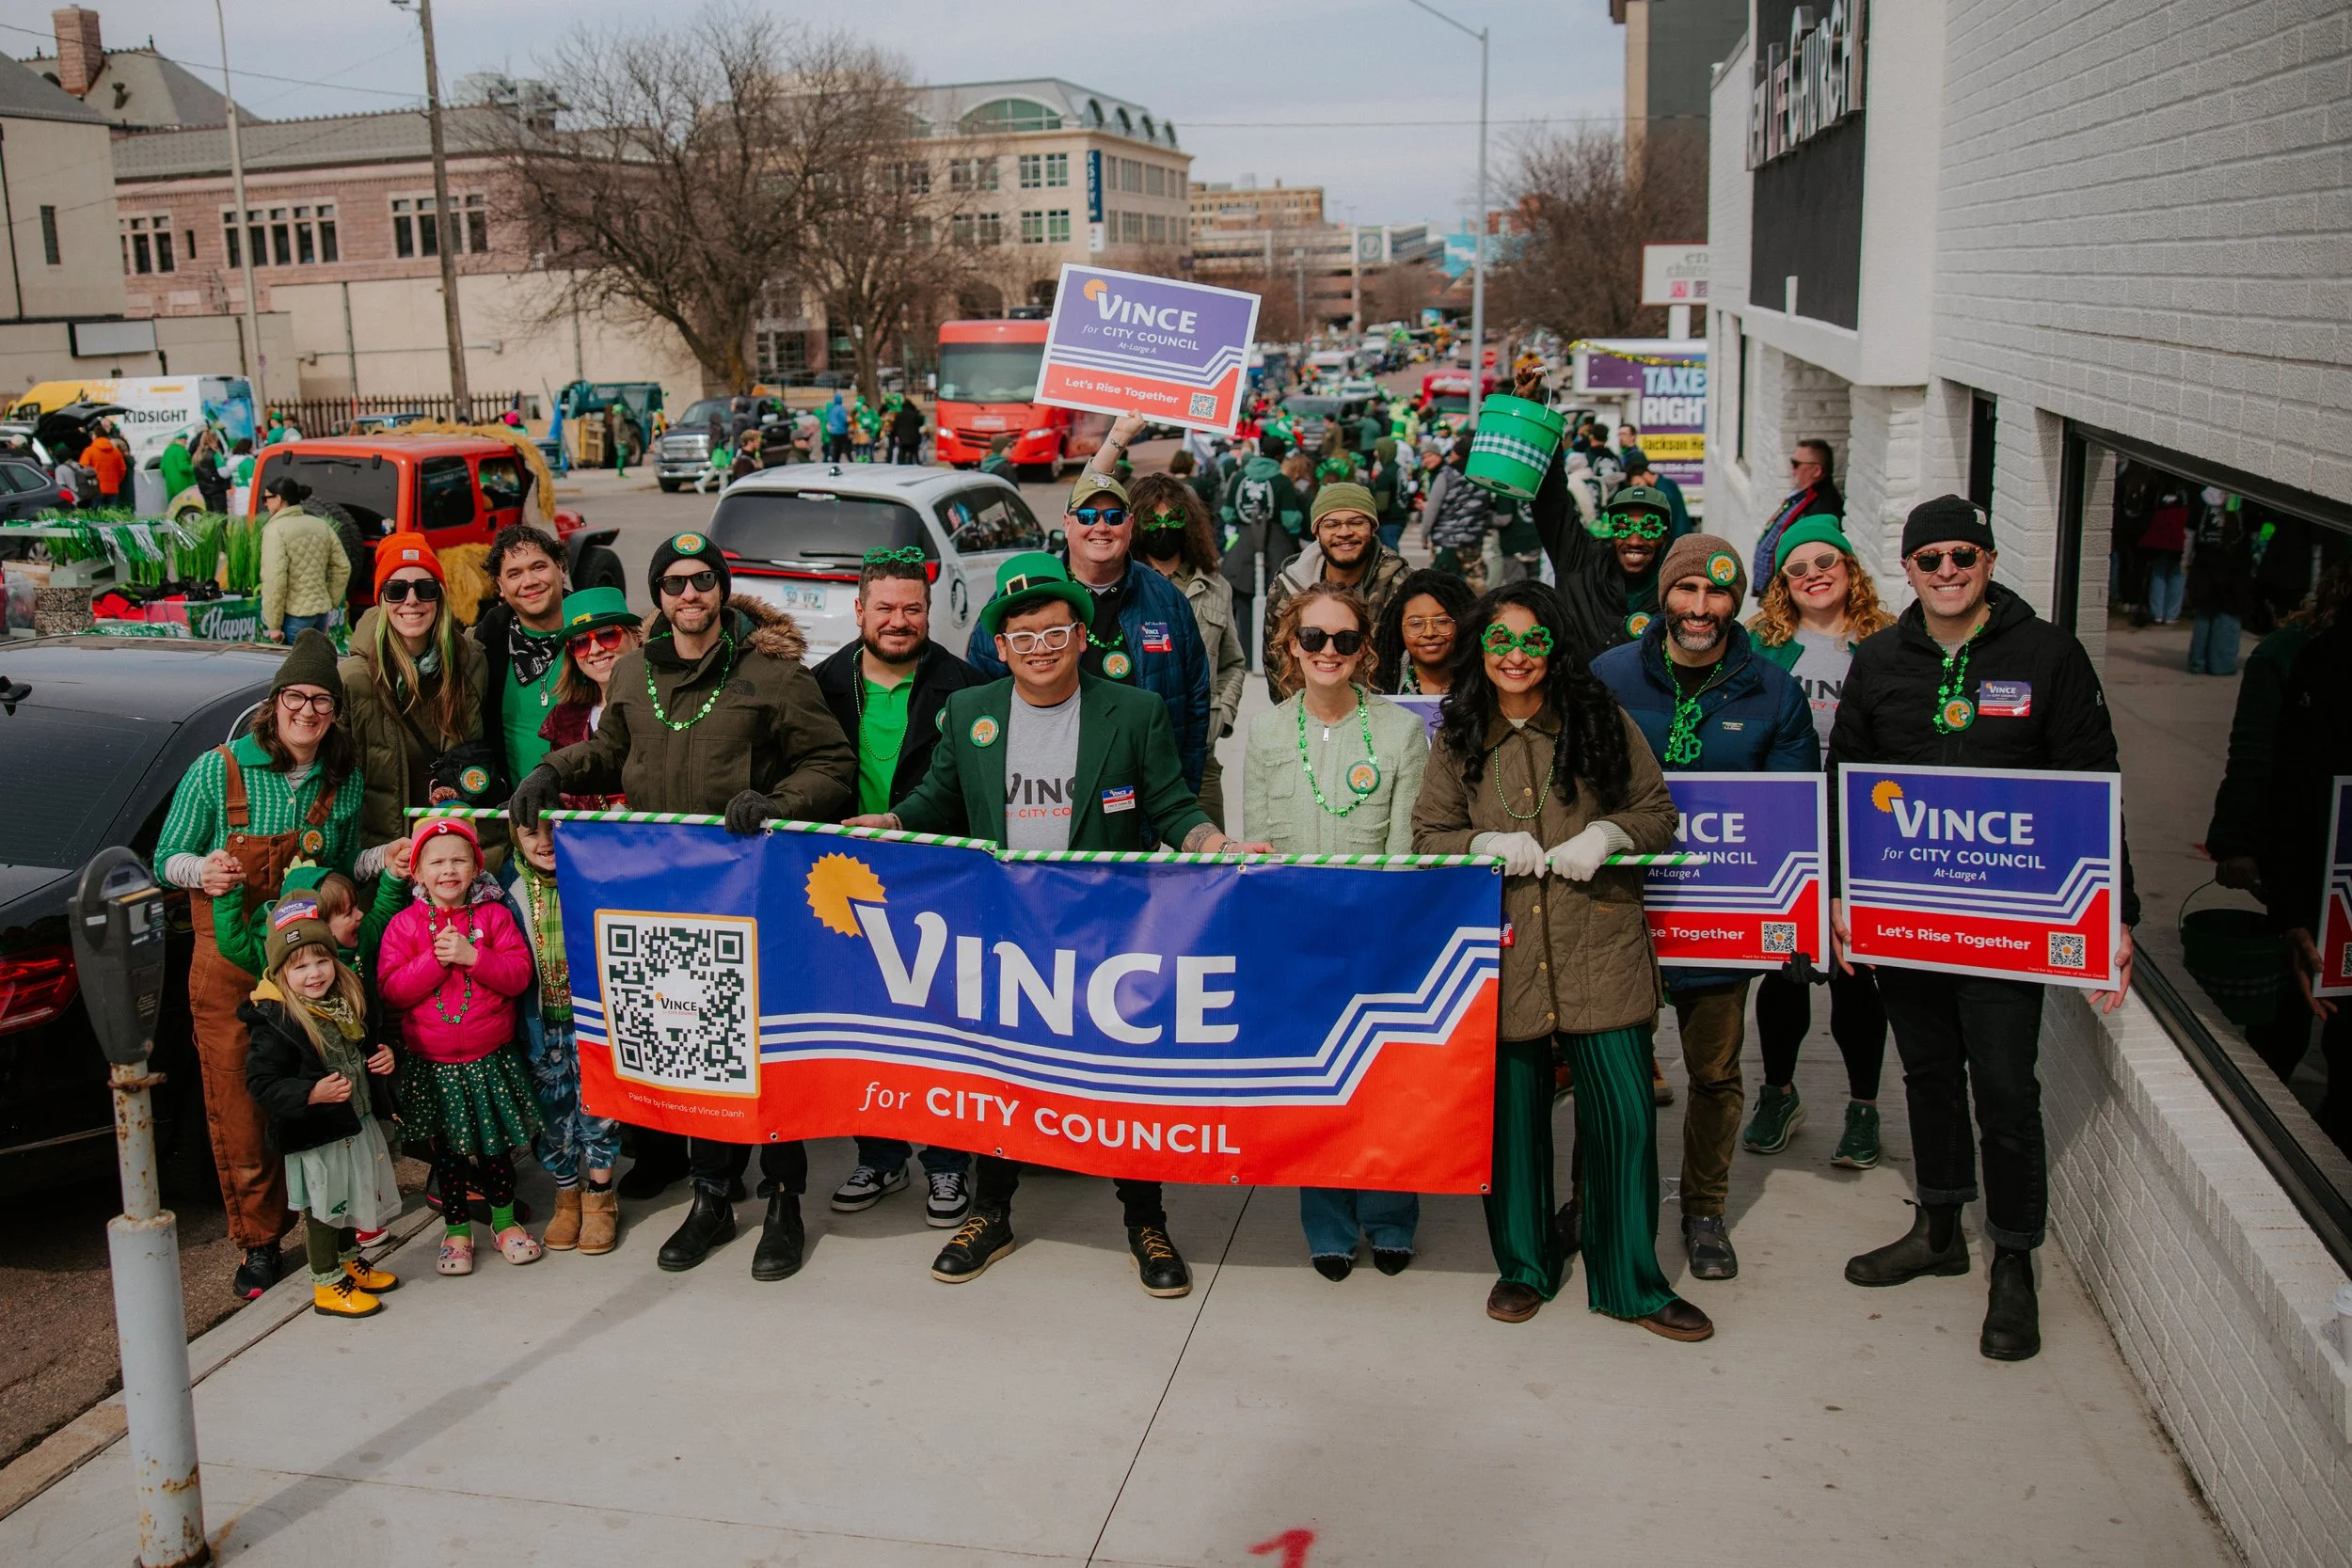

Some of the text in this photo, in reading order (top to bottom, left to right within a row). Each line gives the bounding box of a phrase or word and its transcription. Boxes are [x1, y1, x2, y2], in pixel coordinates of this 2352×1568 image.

[1789, 0, 1863, 148] CHURCH
[1097, 292, 1198, 334] VINCE
[1082, 325, 1200, 351] for CITY COUNCIL
[1118, 341, 1151, 354] At-Large
[1065, 378, 1179, 404] Let's Rise Together
[123, 409, 187, 424] KIDSIGHT
[1644, 436, 1688, 450] Jackson
[200, 606, 256, 642] Happy
[1989, 686, 2017, 694] VINCE
[1019, 809, 1047, 818] CITY
[1052, 807, 1073, 816] CO
[437, 821, 448, 833] S
[1890, 799, 2035, 845] VINCE
[1672, 850, 1757, 864] UNCIL
[1882, 847, 2045, 869] for CITY COUNCIL
[1648, 868, 1700, 880] At-Large A
[1934, 867, 1987, 882] At-Large A
[1669, 927, 1745, 941] Together
[1918, 928, 1951, 942] Rise
[1955, 931, 2031, 950] Together
[853, 904, 1239, 1044] VINCE
[660, 998, 697, 1011] VINCE
[628, 1092, 744, 1118] Paid for by Friends of Vince Danh
[859, 1082, 1241, 1154] for CITY COUNCIL
